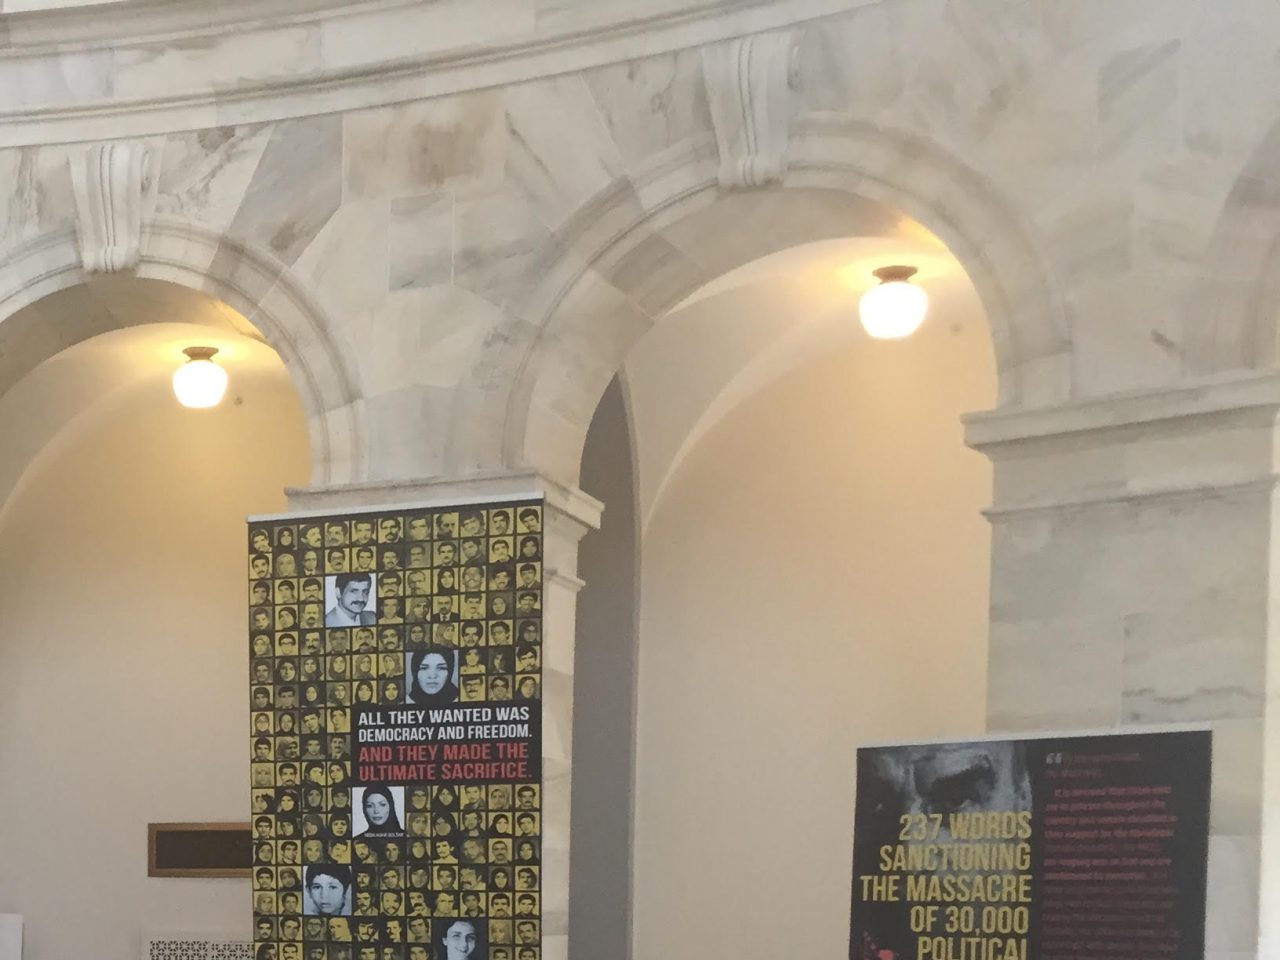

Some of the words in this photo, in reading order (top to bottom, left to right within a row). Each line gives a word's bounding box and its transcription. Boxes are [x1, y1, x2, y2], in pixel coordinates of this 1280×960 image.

[358, 712, 384, 726] ALL
[388, 710, 425, 725] THEY
[429, 708, 491, 723] WANTED
[496, 707, 529, 721] WAS
[359, 727, 433, 742] DEMOCRACY
[438, 726, 464, 740] AND
[468, 724, 532, 739] FREEDOM.
[359, 746, 392, 762] AND
[397, 745, 438, 761] THEY
[444, 743, 491, 760] MADE
[496, 743, 528, 759] THE
[360, 764, 436, 781] ULTIMATE
[442, 762, 532, 780] SACRIFICE.
[899, 813, 943, 840] 237
[949, 811, 1032, 840] WORDS
[880, 843, 1031, 871] SANCTIONING
[860, 875, 900, 901] THE
[907, 875, 1032, 902] MASSACRE
[910, 905, 939, 932] OF
[945, 906, 1029, 935] 30,000
